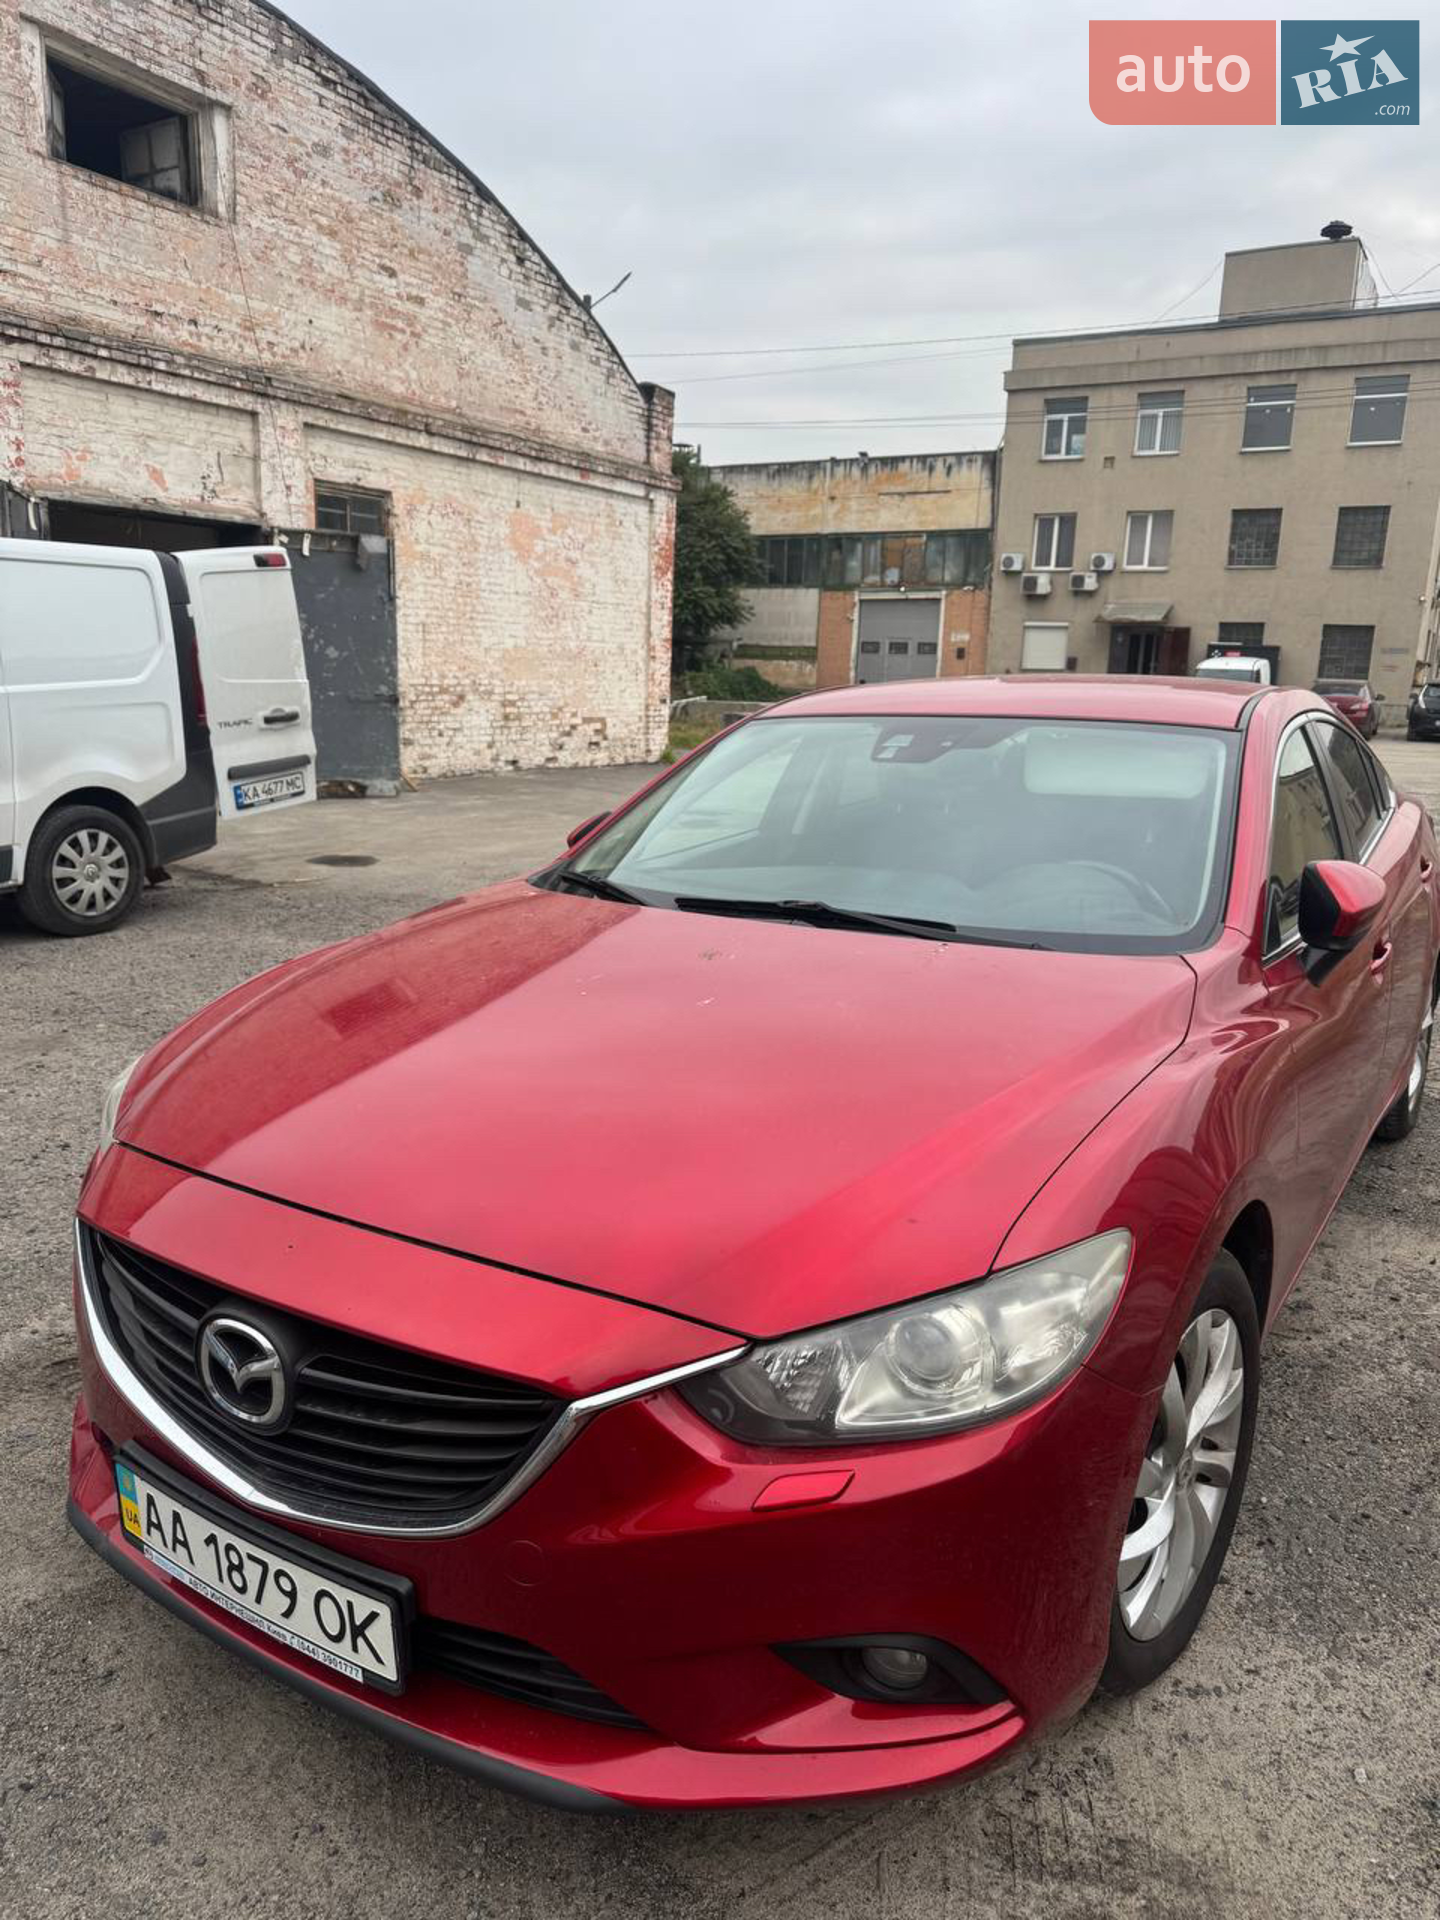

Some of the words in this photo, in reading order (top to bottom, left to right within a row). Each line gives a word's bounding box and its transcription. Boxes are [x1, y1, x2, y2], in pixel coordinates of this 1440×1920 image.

[126, 1508, 140, 1528] UA
[147, 1491, 195, 1566] AA
[204, 1532, 298, 1620] 1879
[314, 1588, 386, 1667] OK
